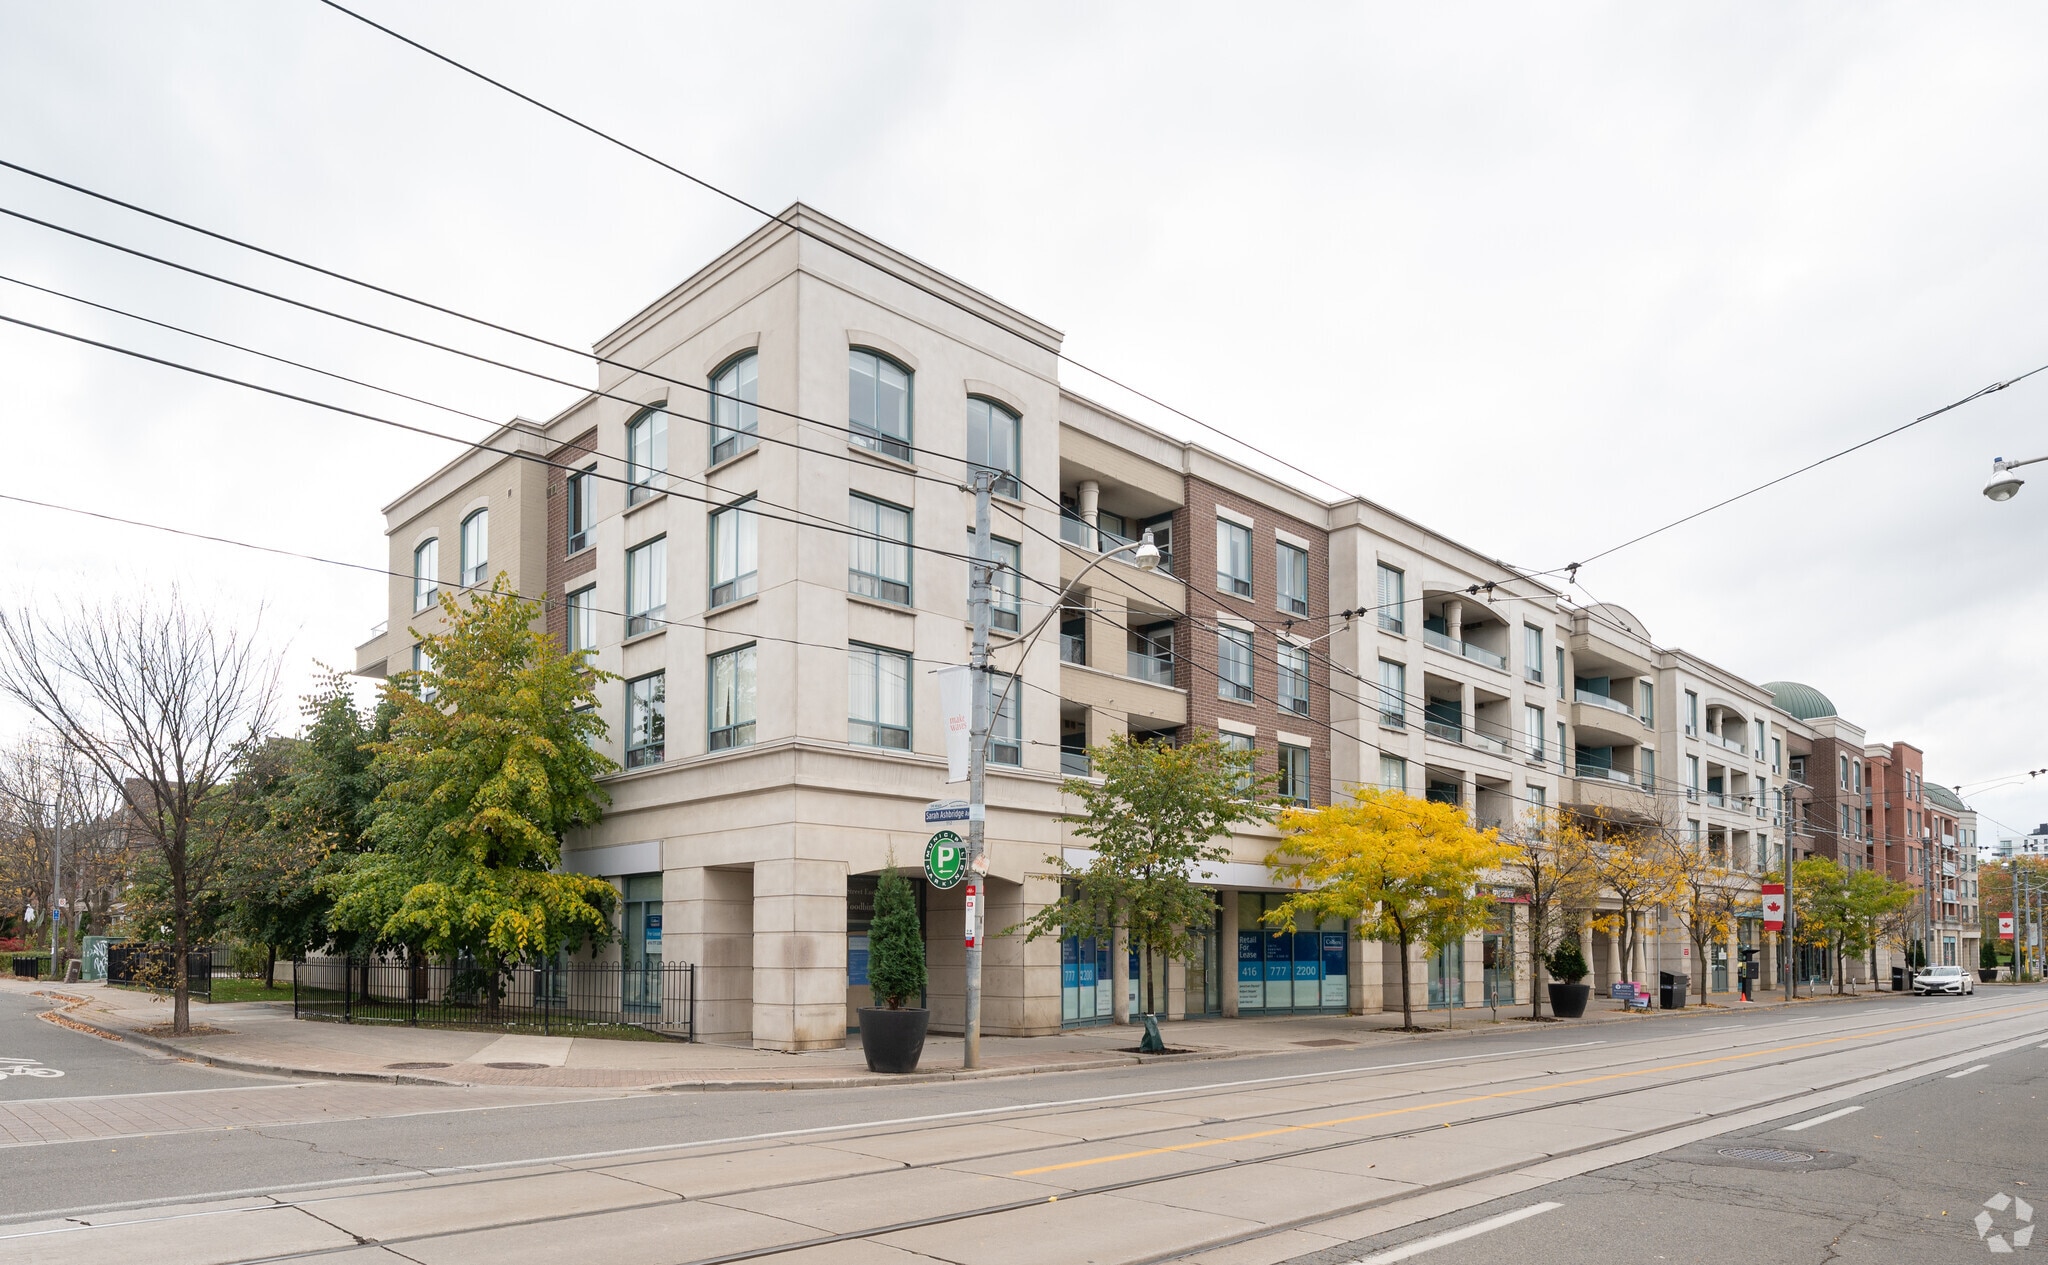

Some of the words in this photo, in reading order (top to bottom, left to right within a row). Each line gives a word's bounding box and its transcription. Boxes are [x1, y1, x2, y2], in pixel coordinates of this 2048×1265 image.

[950, 714, 965, 723] make
[950, 722, 967, 731] waves
[926, 811, 940, 820] Sarah
[940, 809, 964, 820] Ashbridge
[926, 832, 965, 858] MUNICIPL
[938, 845, 955, 868] P
[926, 864, 964, 886] PARKING
[1065, 970, 1075, 982] 777
[1242, 967, 1257, 976] 416
[1270, 966, 1286, 976] 777
[1296, 966, 1316, 976] 2200
